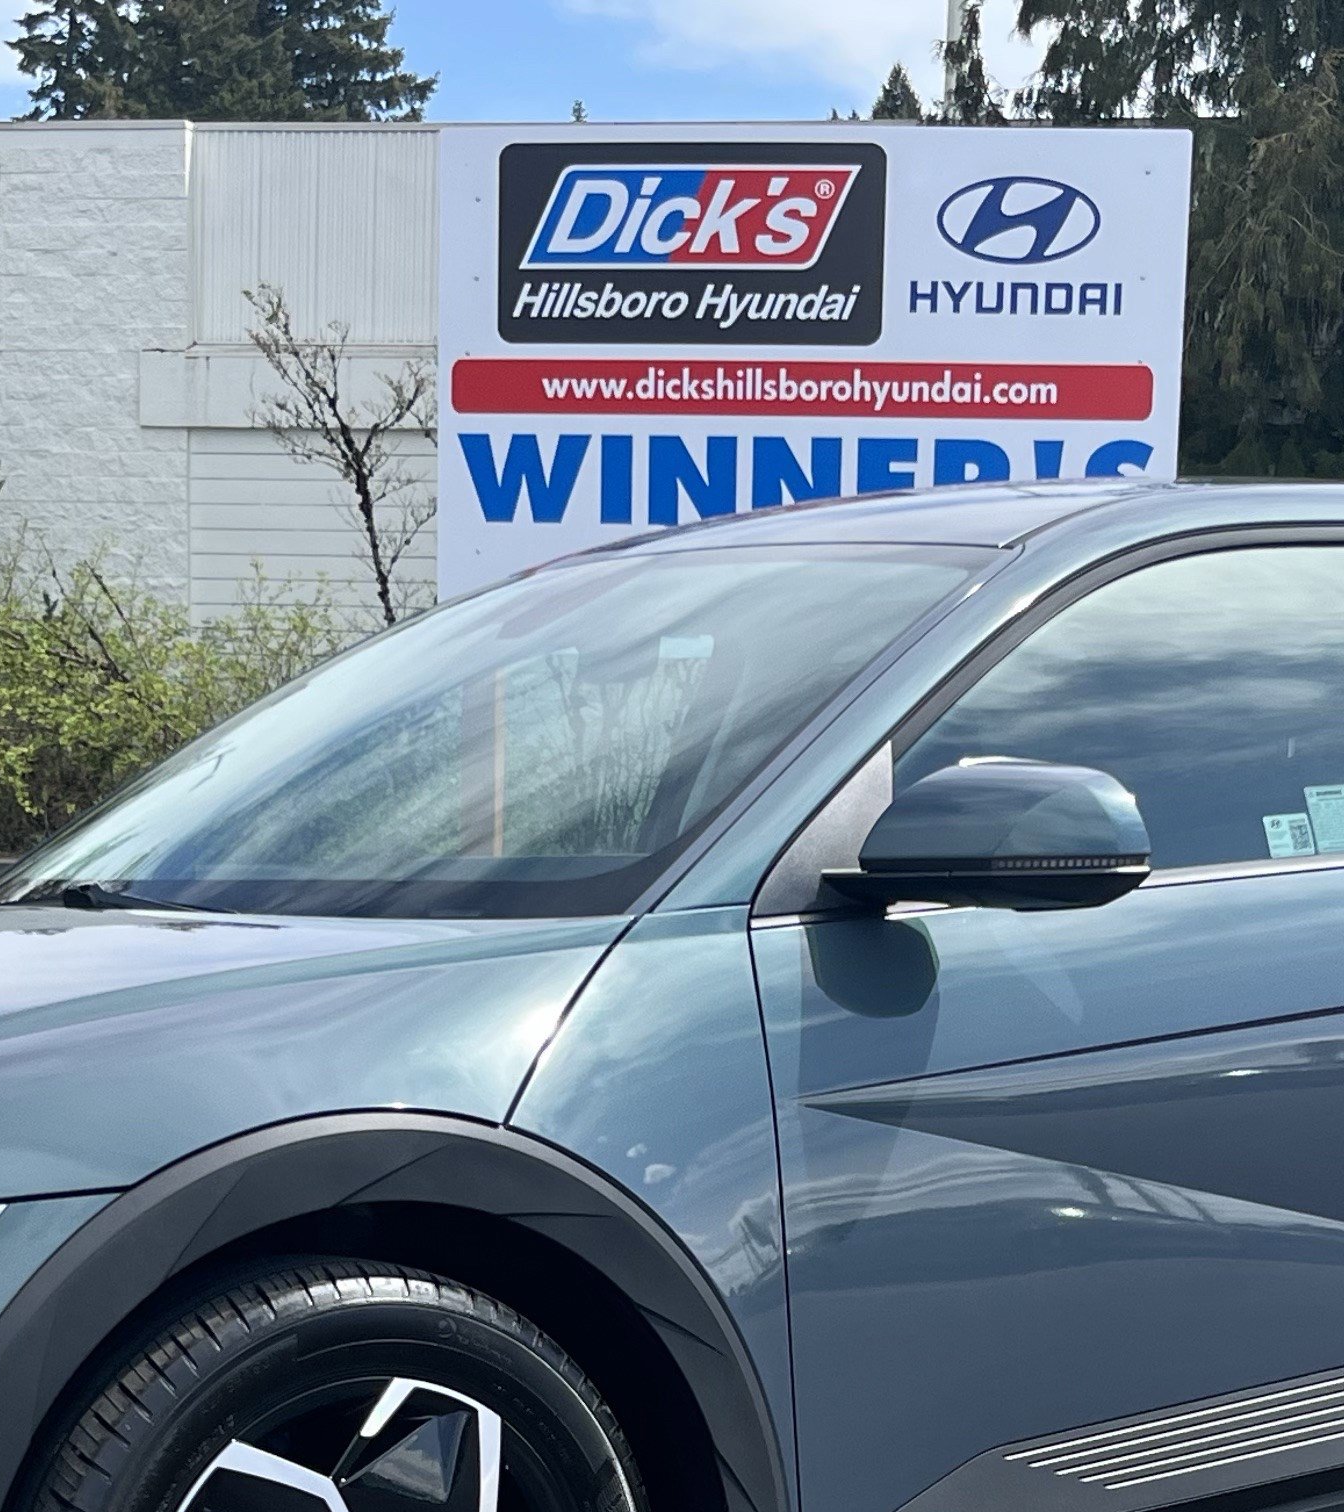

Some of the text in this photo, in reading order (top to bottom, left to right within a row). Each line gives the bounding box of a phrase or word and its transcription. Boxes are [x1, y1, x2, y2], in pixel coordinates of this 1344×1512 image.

[546, 177, 818, 258] Dick's
[512, 282, 861, 329] Hillsboro Hyundai
[909, 280, 1123, 317] HYUNDAI
[542, 369, 1058, 411] www.dickshillsborohyundai.com
